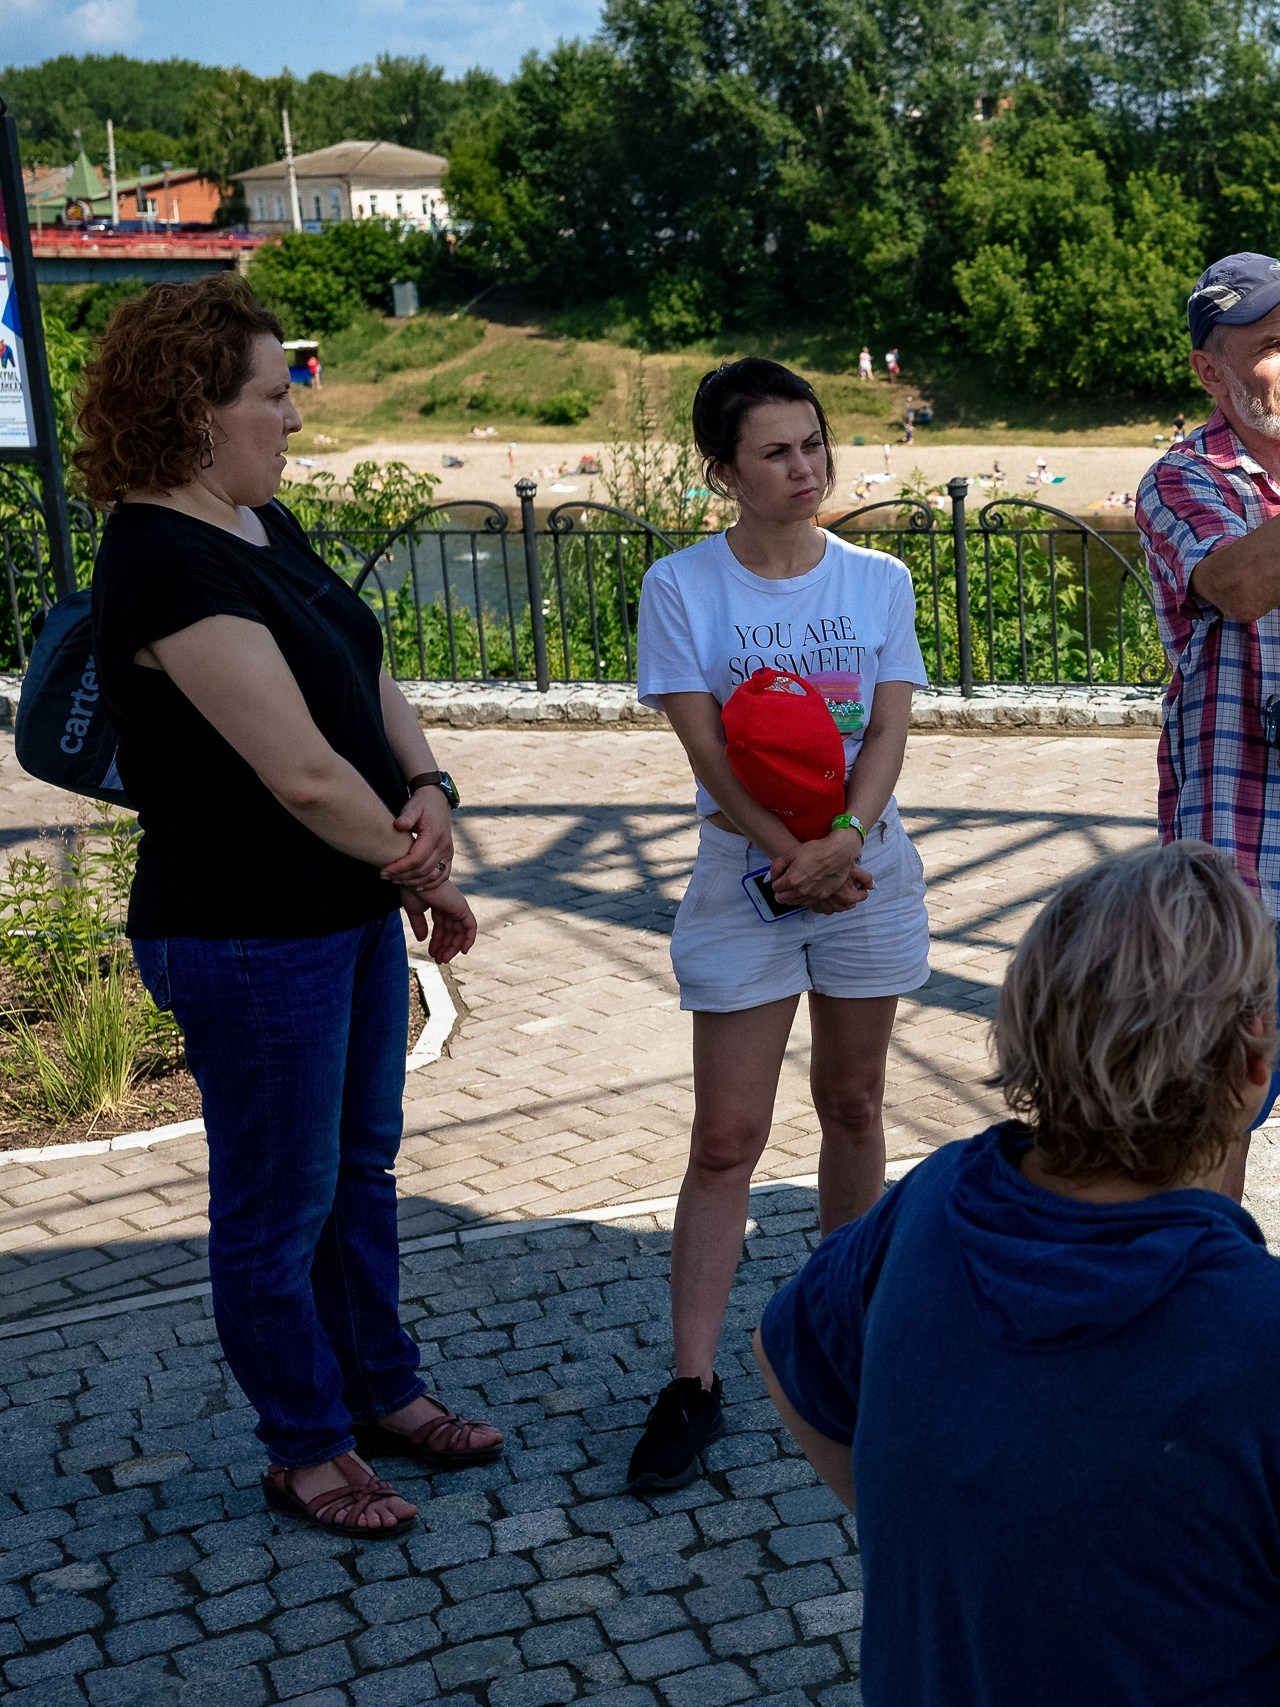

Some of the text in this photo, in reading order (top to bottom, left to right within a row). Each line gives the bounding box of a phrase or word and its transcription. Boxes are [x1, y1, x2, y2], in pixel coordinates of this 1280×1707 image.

[733, 615, 857, 650] YOU ARE
[728, 646, 866, 687] SO SWEET
